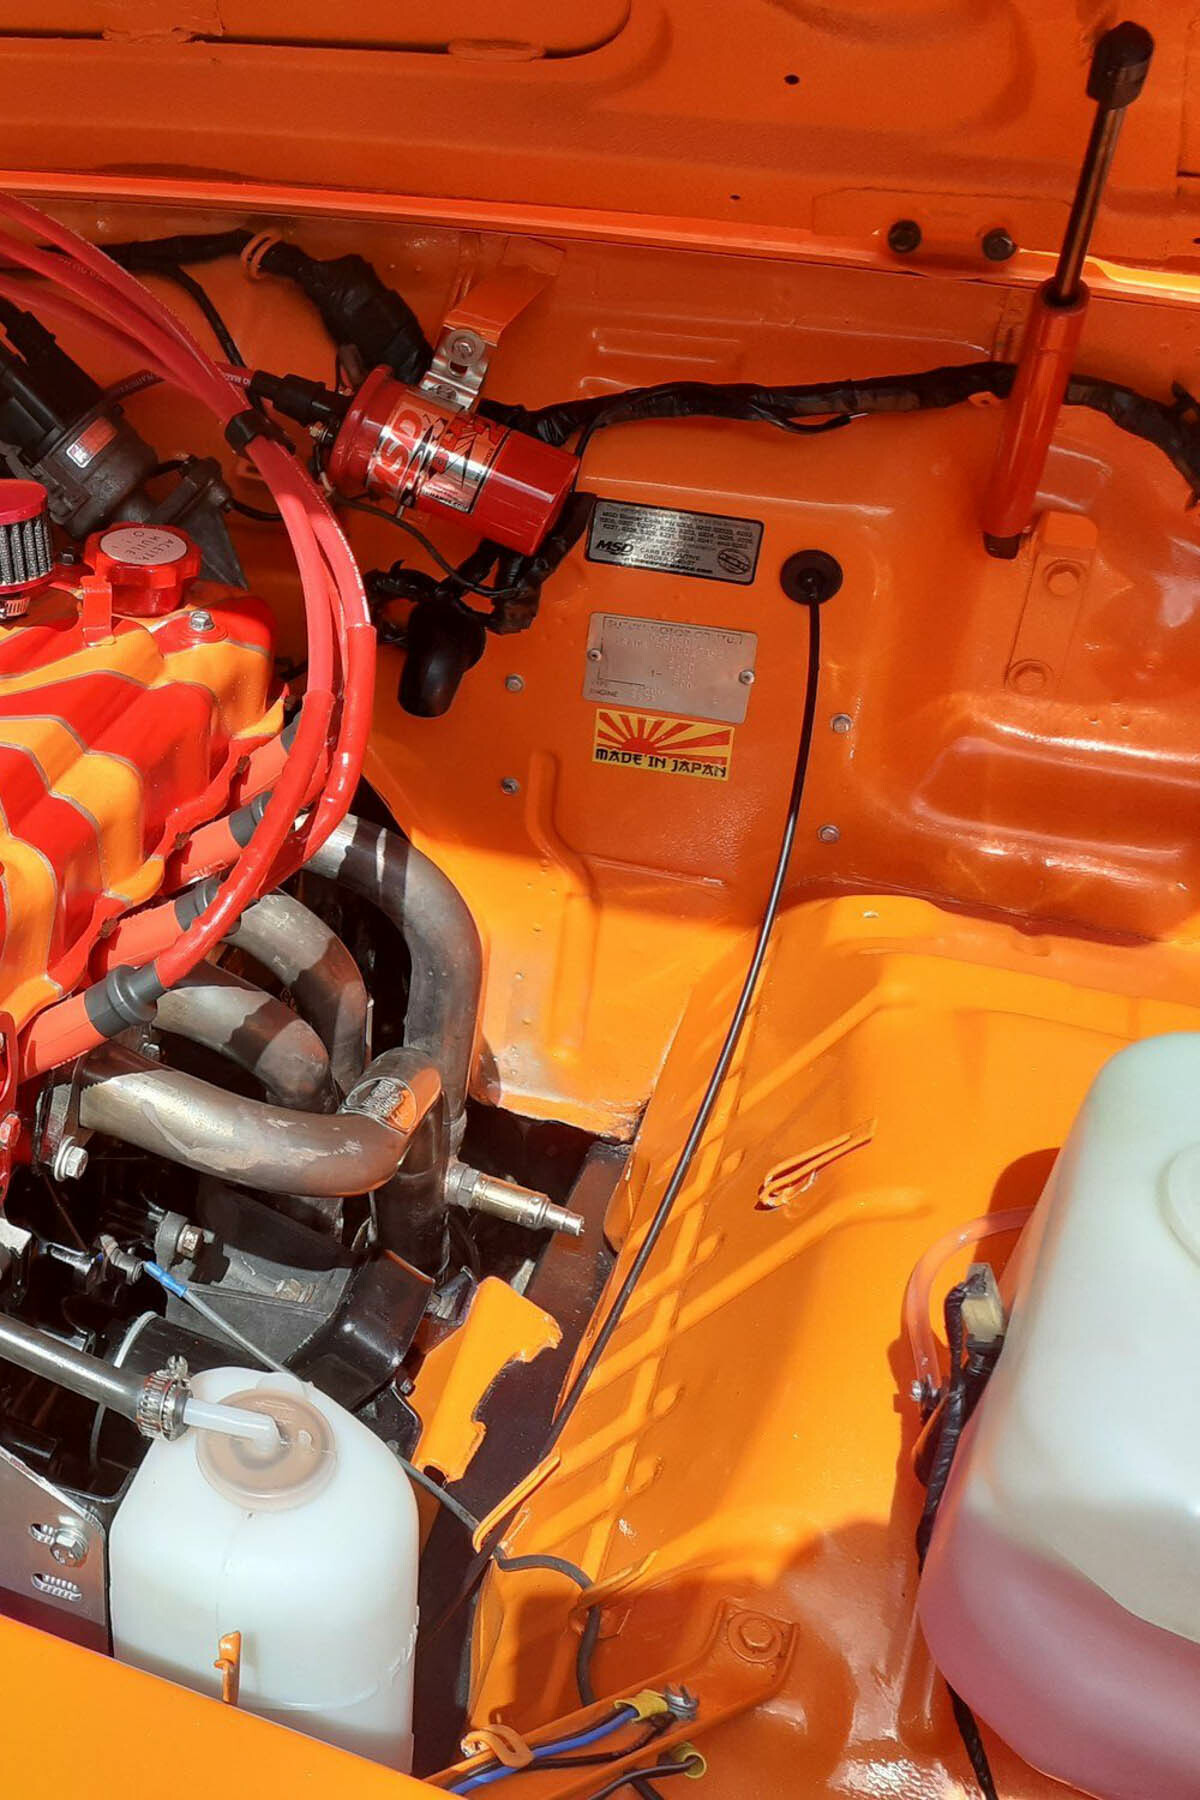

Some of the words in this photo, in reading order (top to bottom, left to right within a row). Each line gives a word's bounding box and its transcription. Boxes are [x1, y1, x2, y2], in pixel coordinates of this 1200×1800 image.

[595, 539, 634, 556] MSD
[595, 748, 642, 766] MADE
[648, 755, 667, 774] IN
[671, 759, 728, 778] JAPAN
